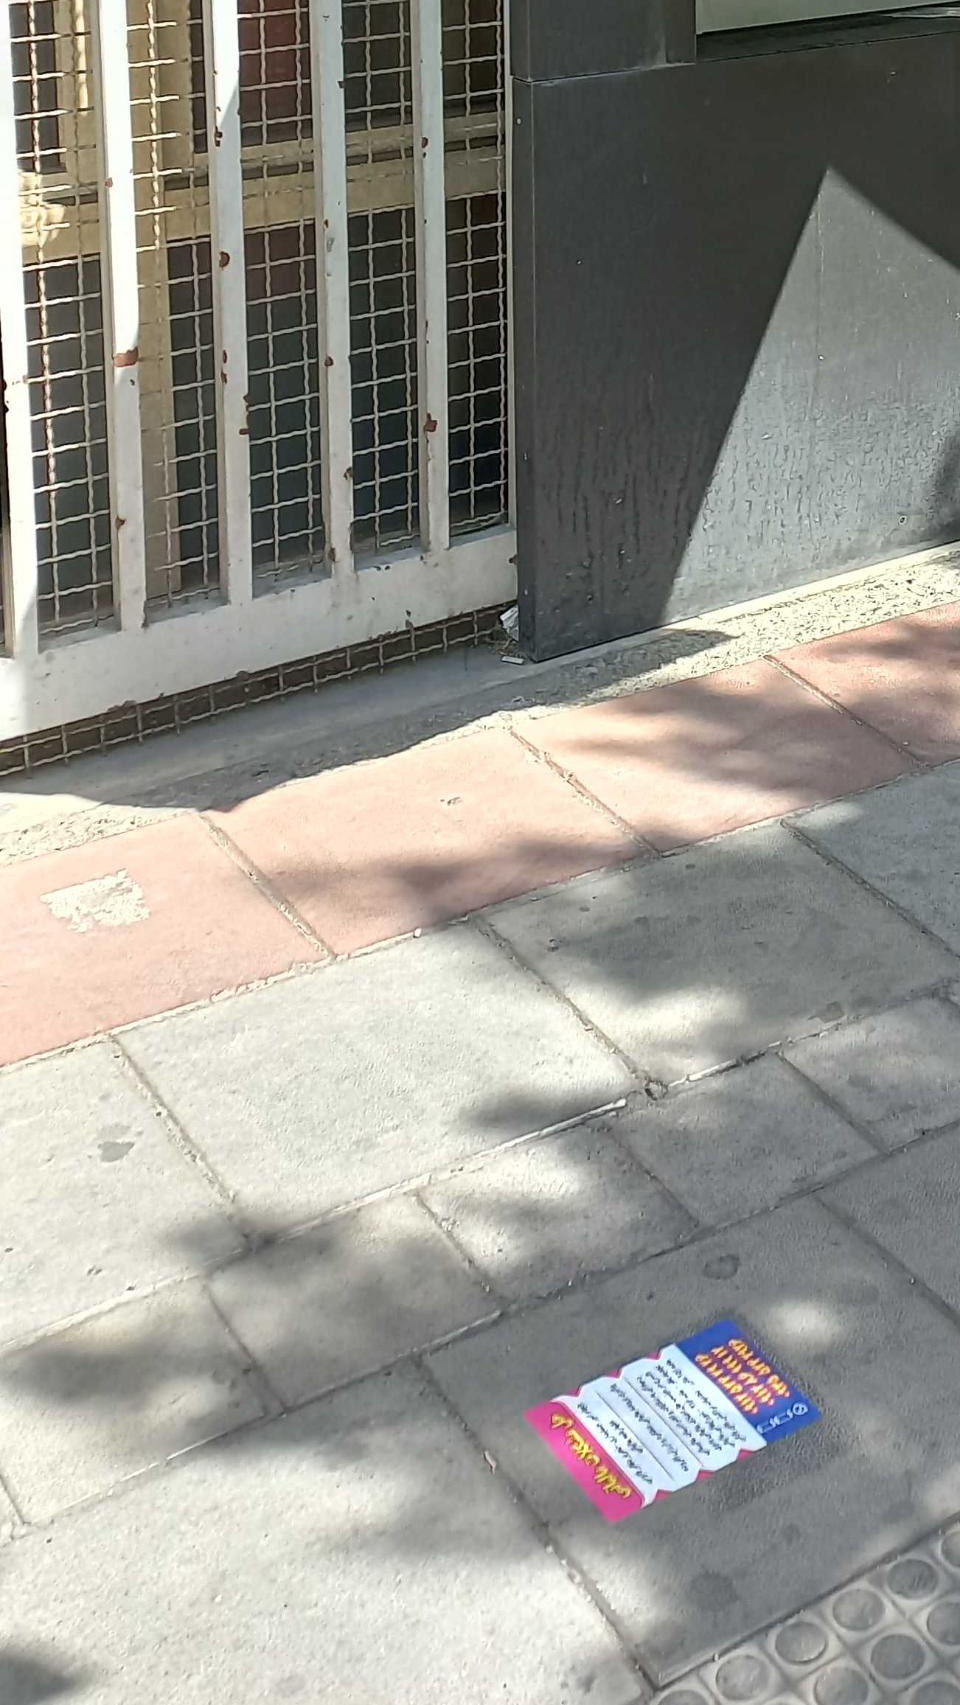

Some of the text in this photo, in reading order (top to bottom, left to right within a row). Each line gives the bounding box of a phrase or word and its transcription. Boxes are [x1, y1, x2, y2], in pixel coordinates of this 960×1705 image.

[551, 1413, 574, 1429] حل
[566, 1428, 601, 1466] مشکلات
[594, 1465, 632, 1500] مالیاتی
